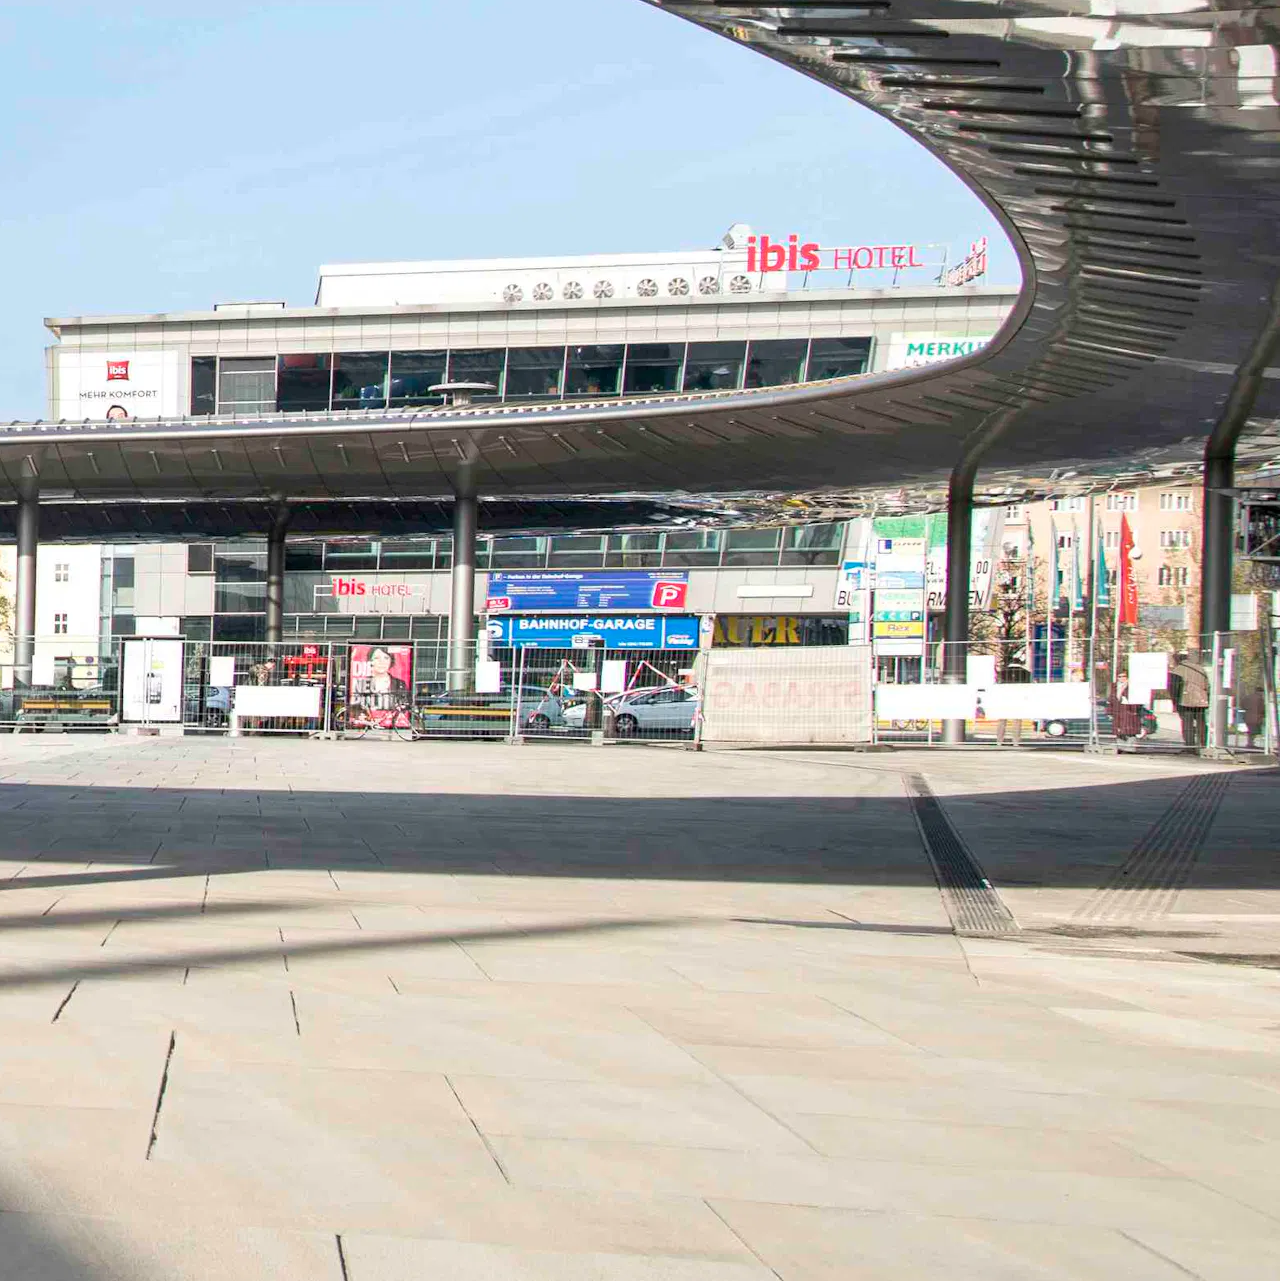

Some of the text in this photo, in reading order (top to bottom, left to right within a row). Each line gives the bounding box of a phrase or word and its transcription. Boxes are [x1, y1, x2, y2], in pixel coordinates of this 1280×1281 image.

[747, 235, 820, 272] ibis
[834, 246, 924, 269] HOTEL
[109, 366, 126, 375] ibis
[80, 390, 157, 399] MEHR KOMFORT
[331, 578, 412, 596] ibis HOTEL
[519, 618, 656, 631] BAHNHOF-GARAGE
